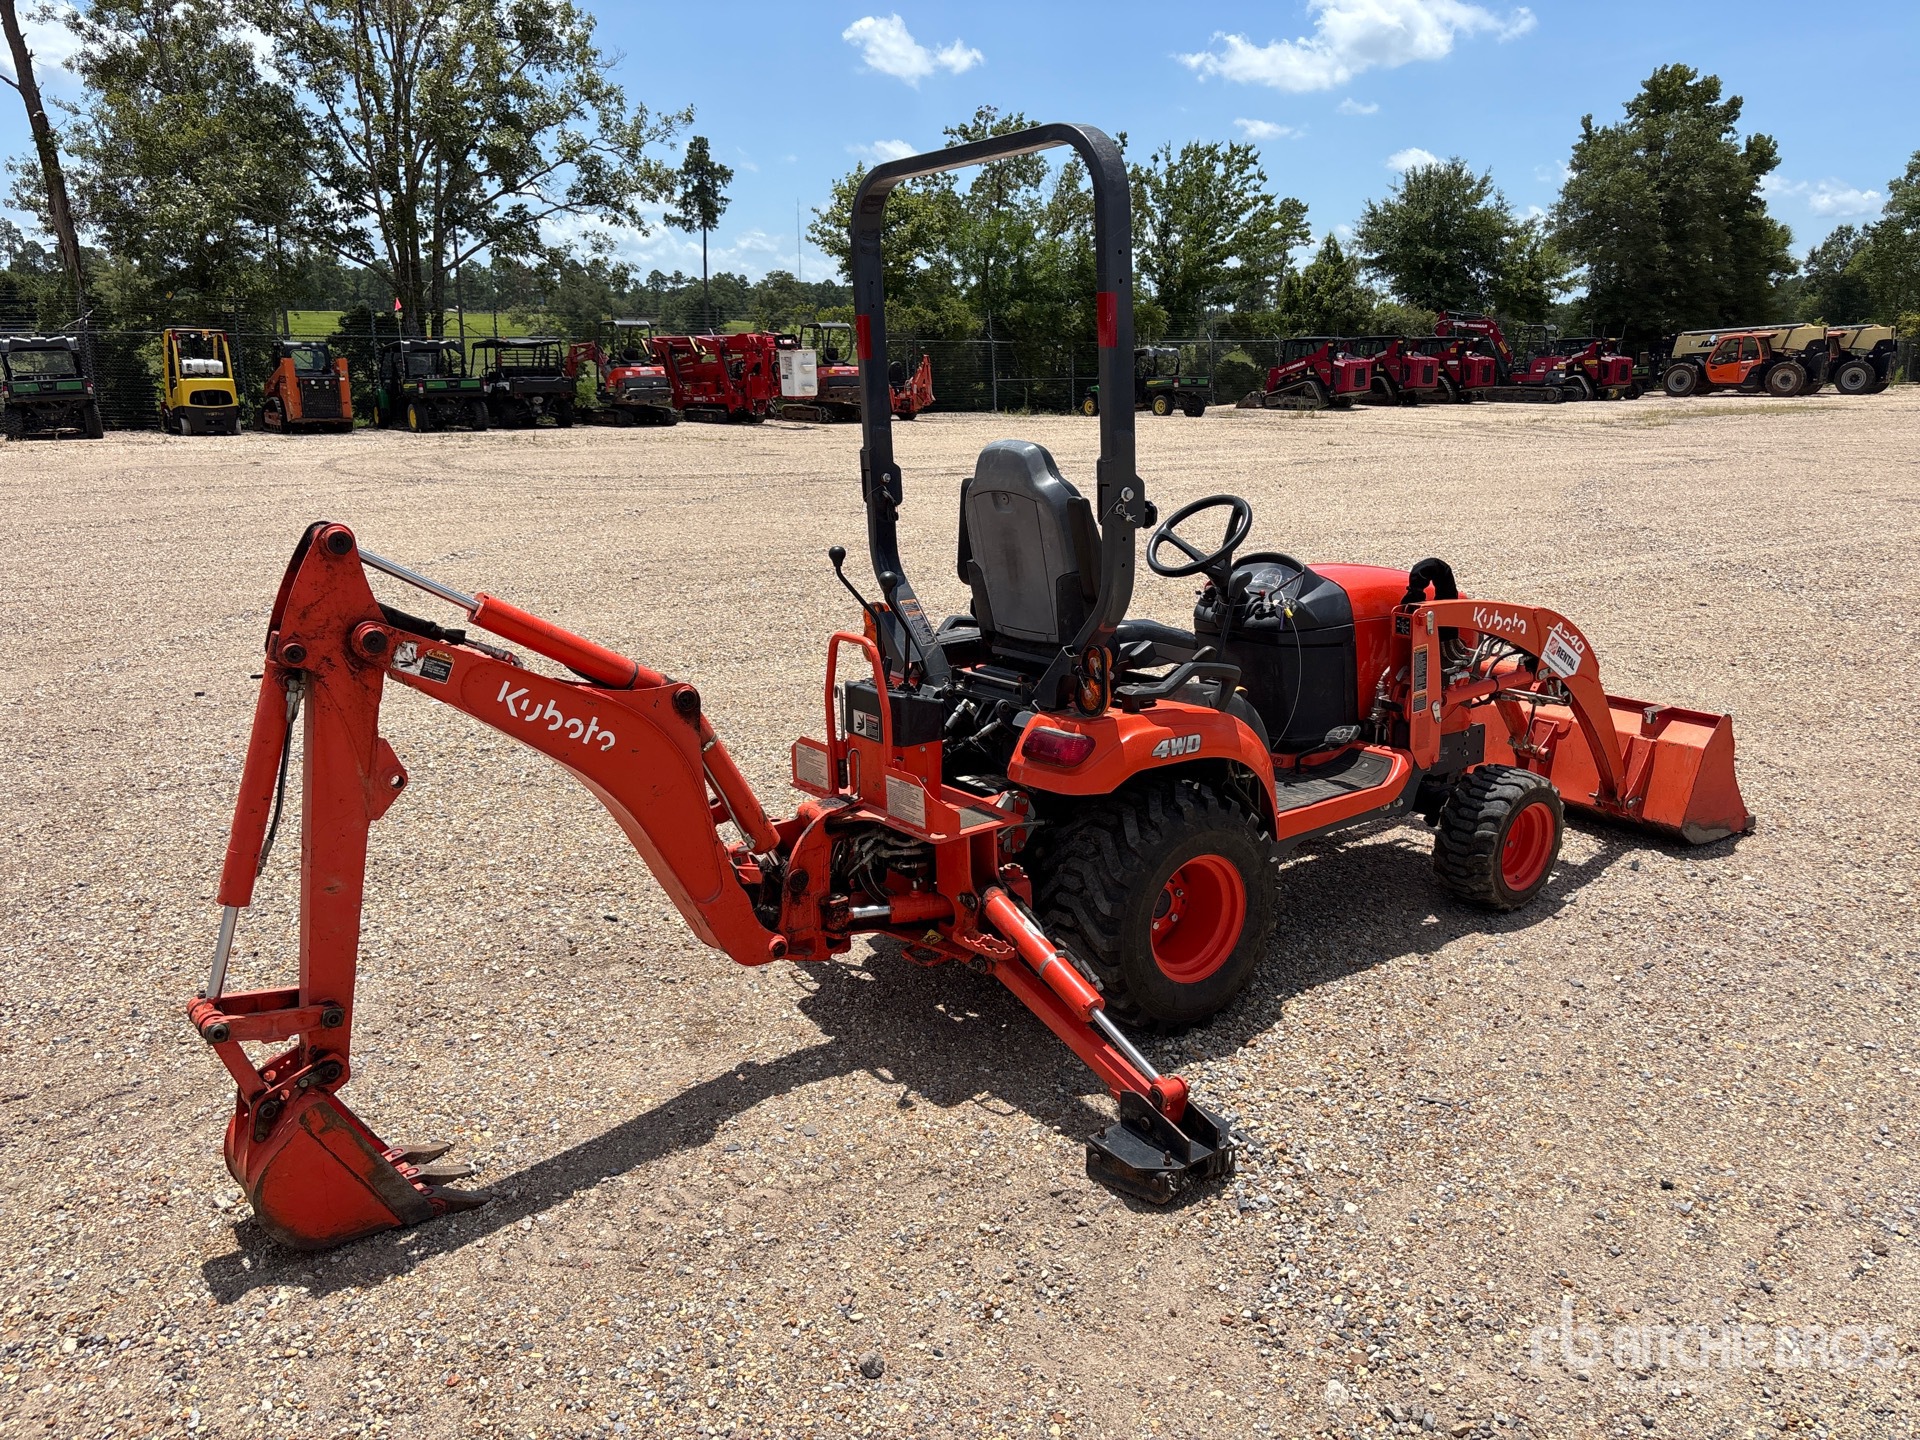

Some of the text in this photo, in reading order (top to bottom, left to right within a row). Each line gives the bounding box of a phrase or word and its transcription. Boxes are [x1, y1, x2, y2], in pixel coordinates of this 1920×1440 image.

[1285, 360, 1307, 372] YANMAR
[1472, 606, 1527, 635] Kubota
[1556, 646, 1577, 671] RENTAL
[496, 680, 616, 752] Kubota
[1152, 733, 1201, 759] 4WD
